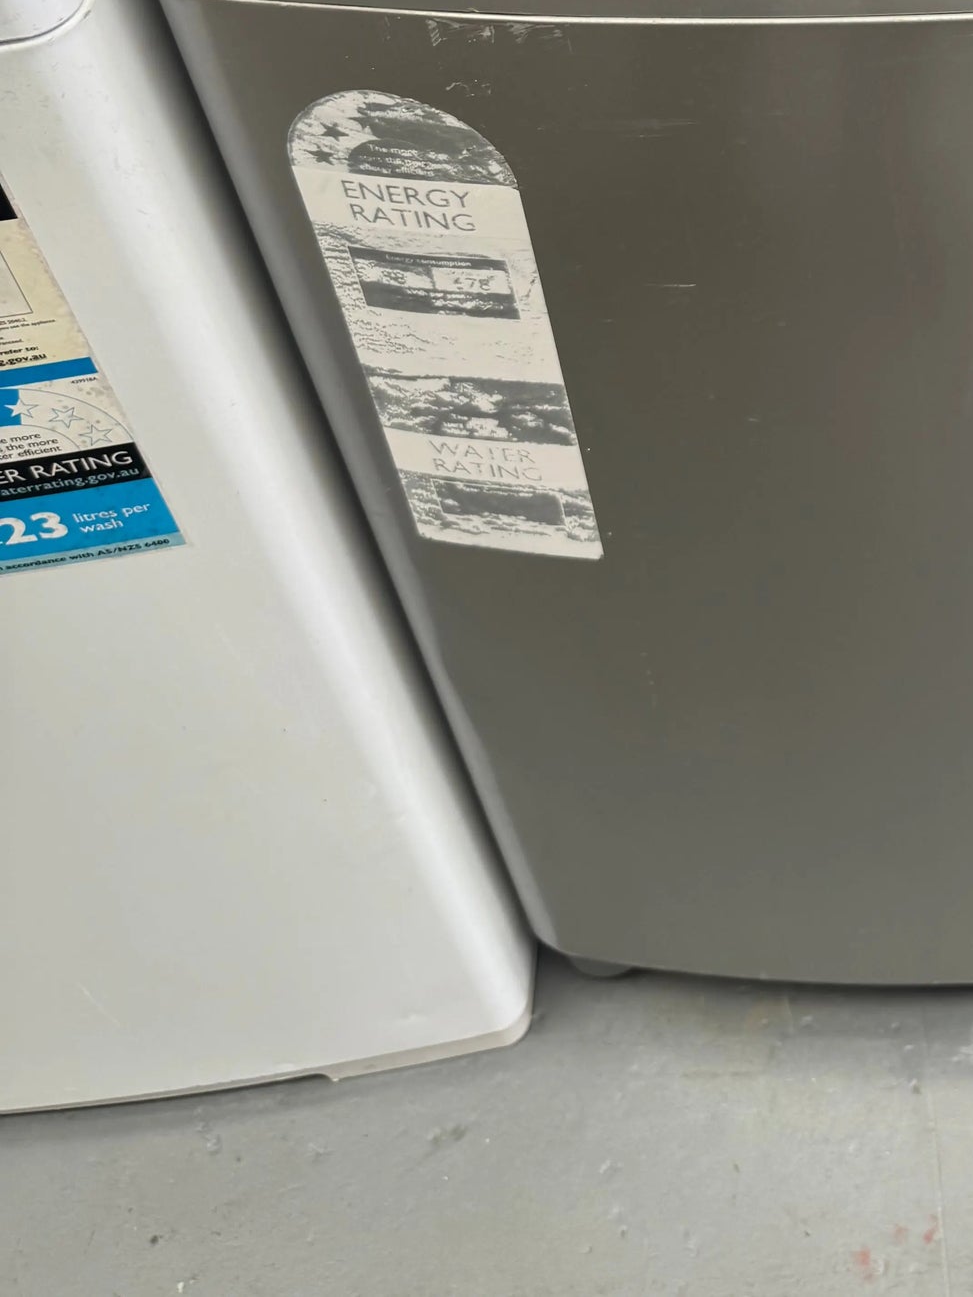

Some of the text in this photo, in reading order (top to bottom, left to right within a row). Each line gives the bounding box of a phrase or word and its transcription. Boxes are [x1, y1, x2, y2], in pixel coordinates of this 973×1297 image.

[341, 179, 469, 209] ENERGY
[350, 203, 476, 232] RATING
[6, 440, 26, 452] the
[28, 438, 59, 449] more
[10, 432, 42, 442] more
[18, 446, 62, 458] efficient
[30, 450, 133, 480] RATING
[72, 503, 151, 524] litres per
[0, 512, 69, 546] 23
[80, 519, 124, 534] wash
[6, 556, 67, 570] accordance
[69, 552, 95, 561] with
[97, 543, 142, 557] AS/NZS
